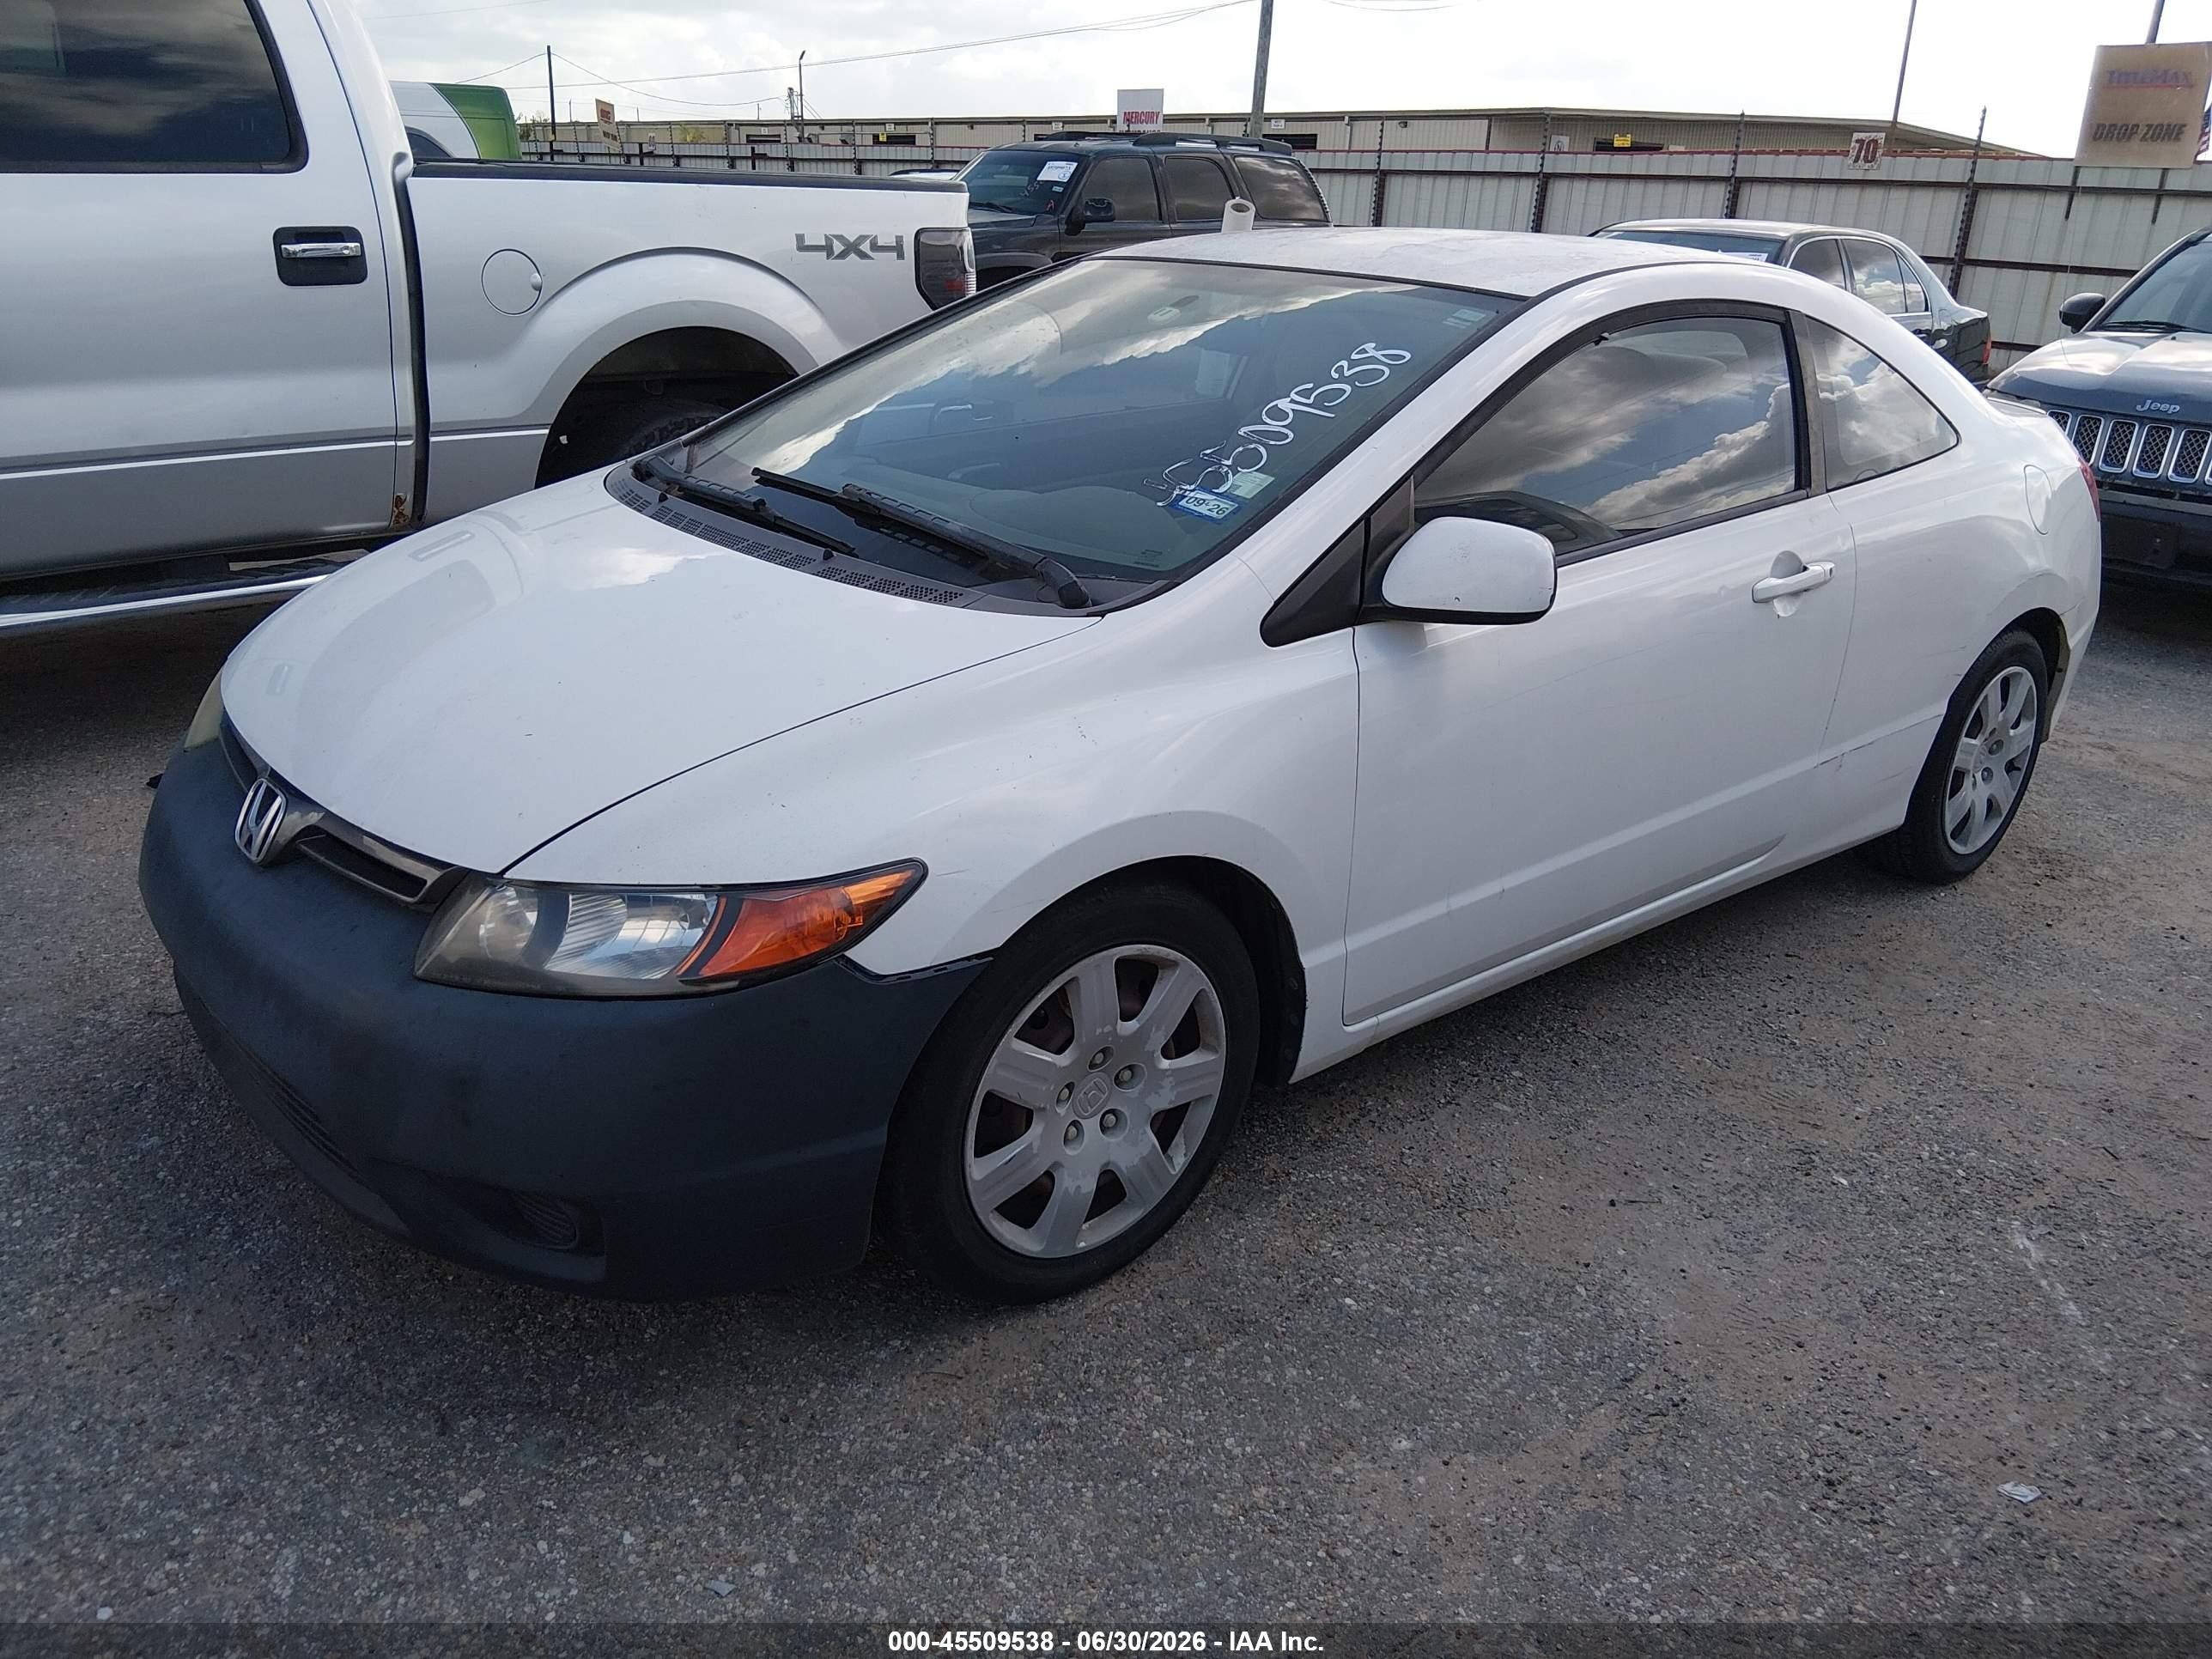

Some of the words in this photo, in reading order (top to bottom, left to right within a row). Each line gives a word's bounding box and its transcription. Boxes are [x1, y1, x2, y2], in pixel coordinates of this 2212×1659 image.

[1122, 111, 1160, 125] MERCURY
[2092, 123, 2140, 143] DROP
[2140, 123, 2187, 143] ZONE
[1853, 138, 1879, 164] 70
[794, 233, 905, 261] 4X4
[2136, 399, 2180, 414] Jeep
[1185, 496, 1206, 507] 09
[1206, 503, 1229, 516] 26
